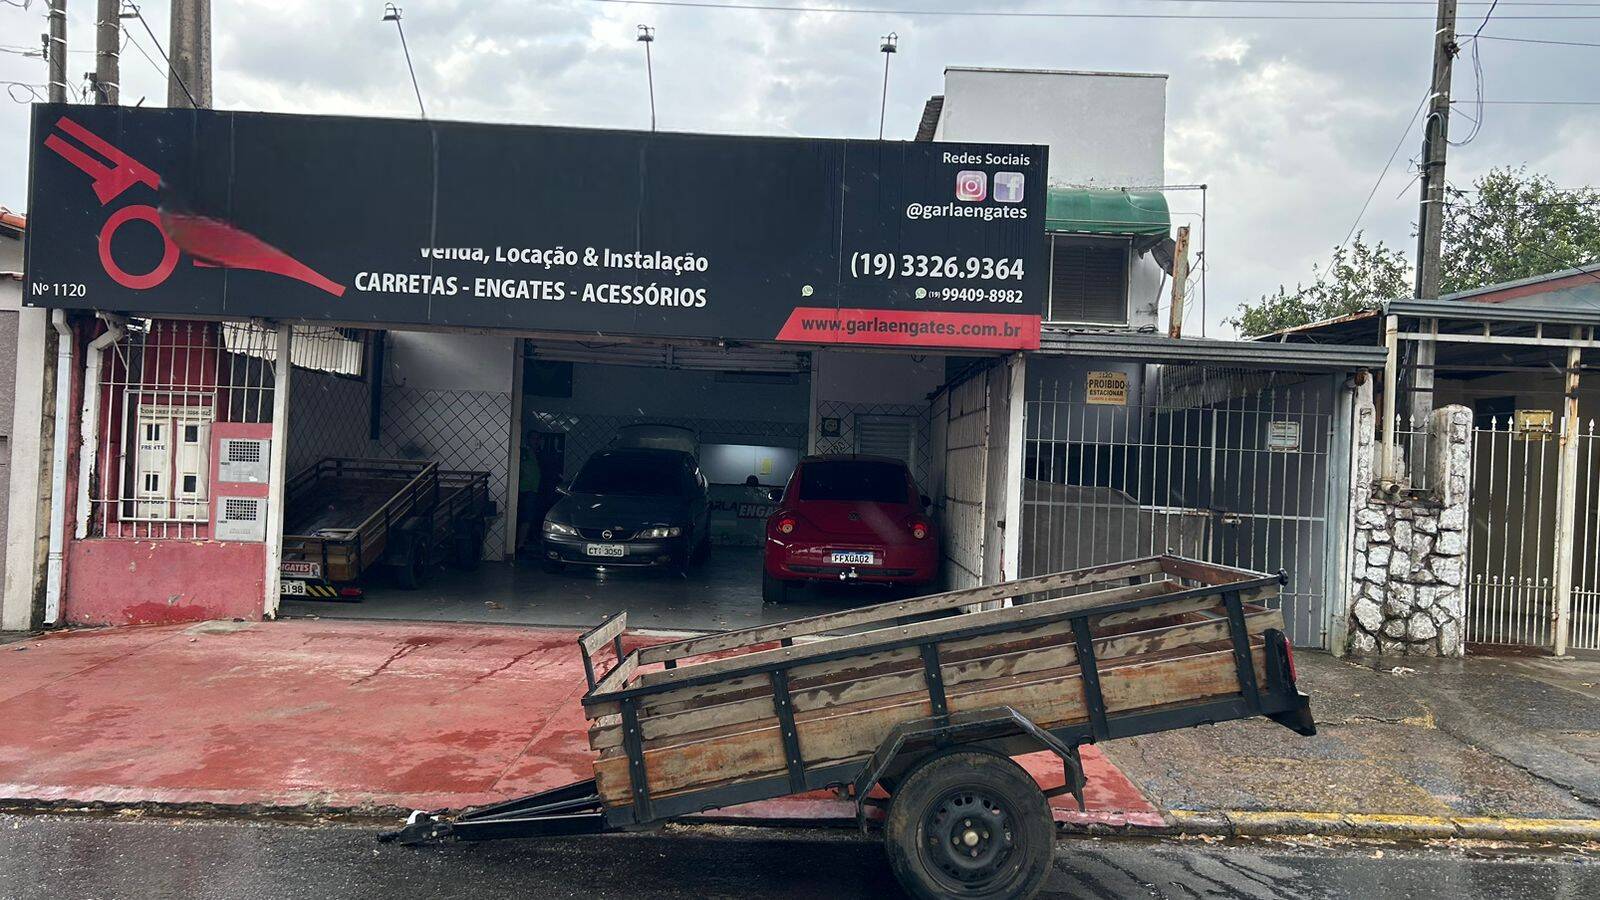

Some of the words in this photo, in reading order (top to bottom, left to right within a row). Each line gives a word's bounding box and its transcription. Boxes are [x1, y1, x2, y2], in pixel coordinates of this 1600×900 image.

[942, 152, 982, 165] Redes
[985, 152, 1031, 166] Sociais
[906, 202, 1028, 221] @garlaengates
[495, 246, 579, 270] Locação
[582, 247, 599, 267] &
[603, 248, 709, 276] Instalação
[850, 251, 896, 280] (19)
[901, 253, 1025, 280] 3326.9364
[53, 283, 86, 297] 1120
[354, 271, 458, 296] CARRETAS
[474, 277, 565, 301] ENGATES
[582, 282, 707, 308] ACESSÓRIOS
[942, 287, 1023, 304] 99409-8982
[801, 316, 1022, 338] www.garlaengates.com.br
[1088, 379, 1125, 389] PROIBIDO
[604, 548, 623, 556] 3050
